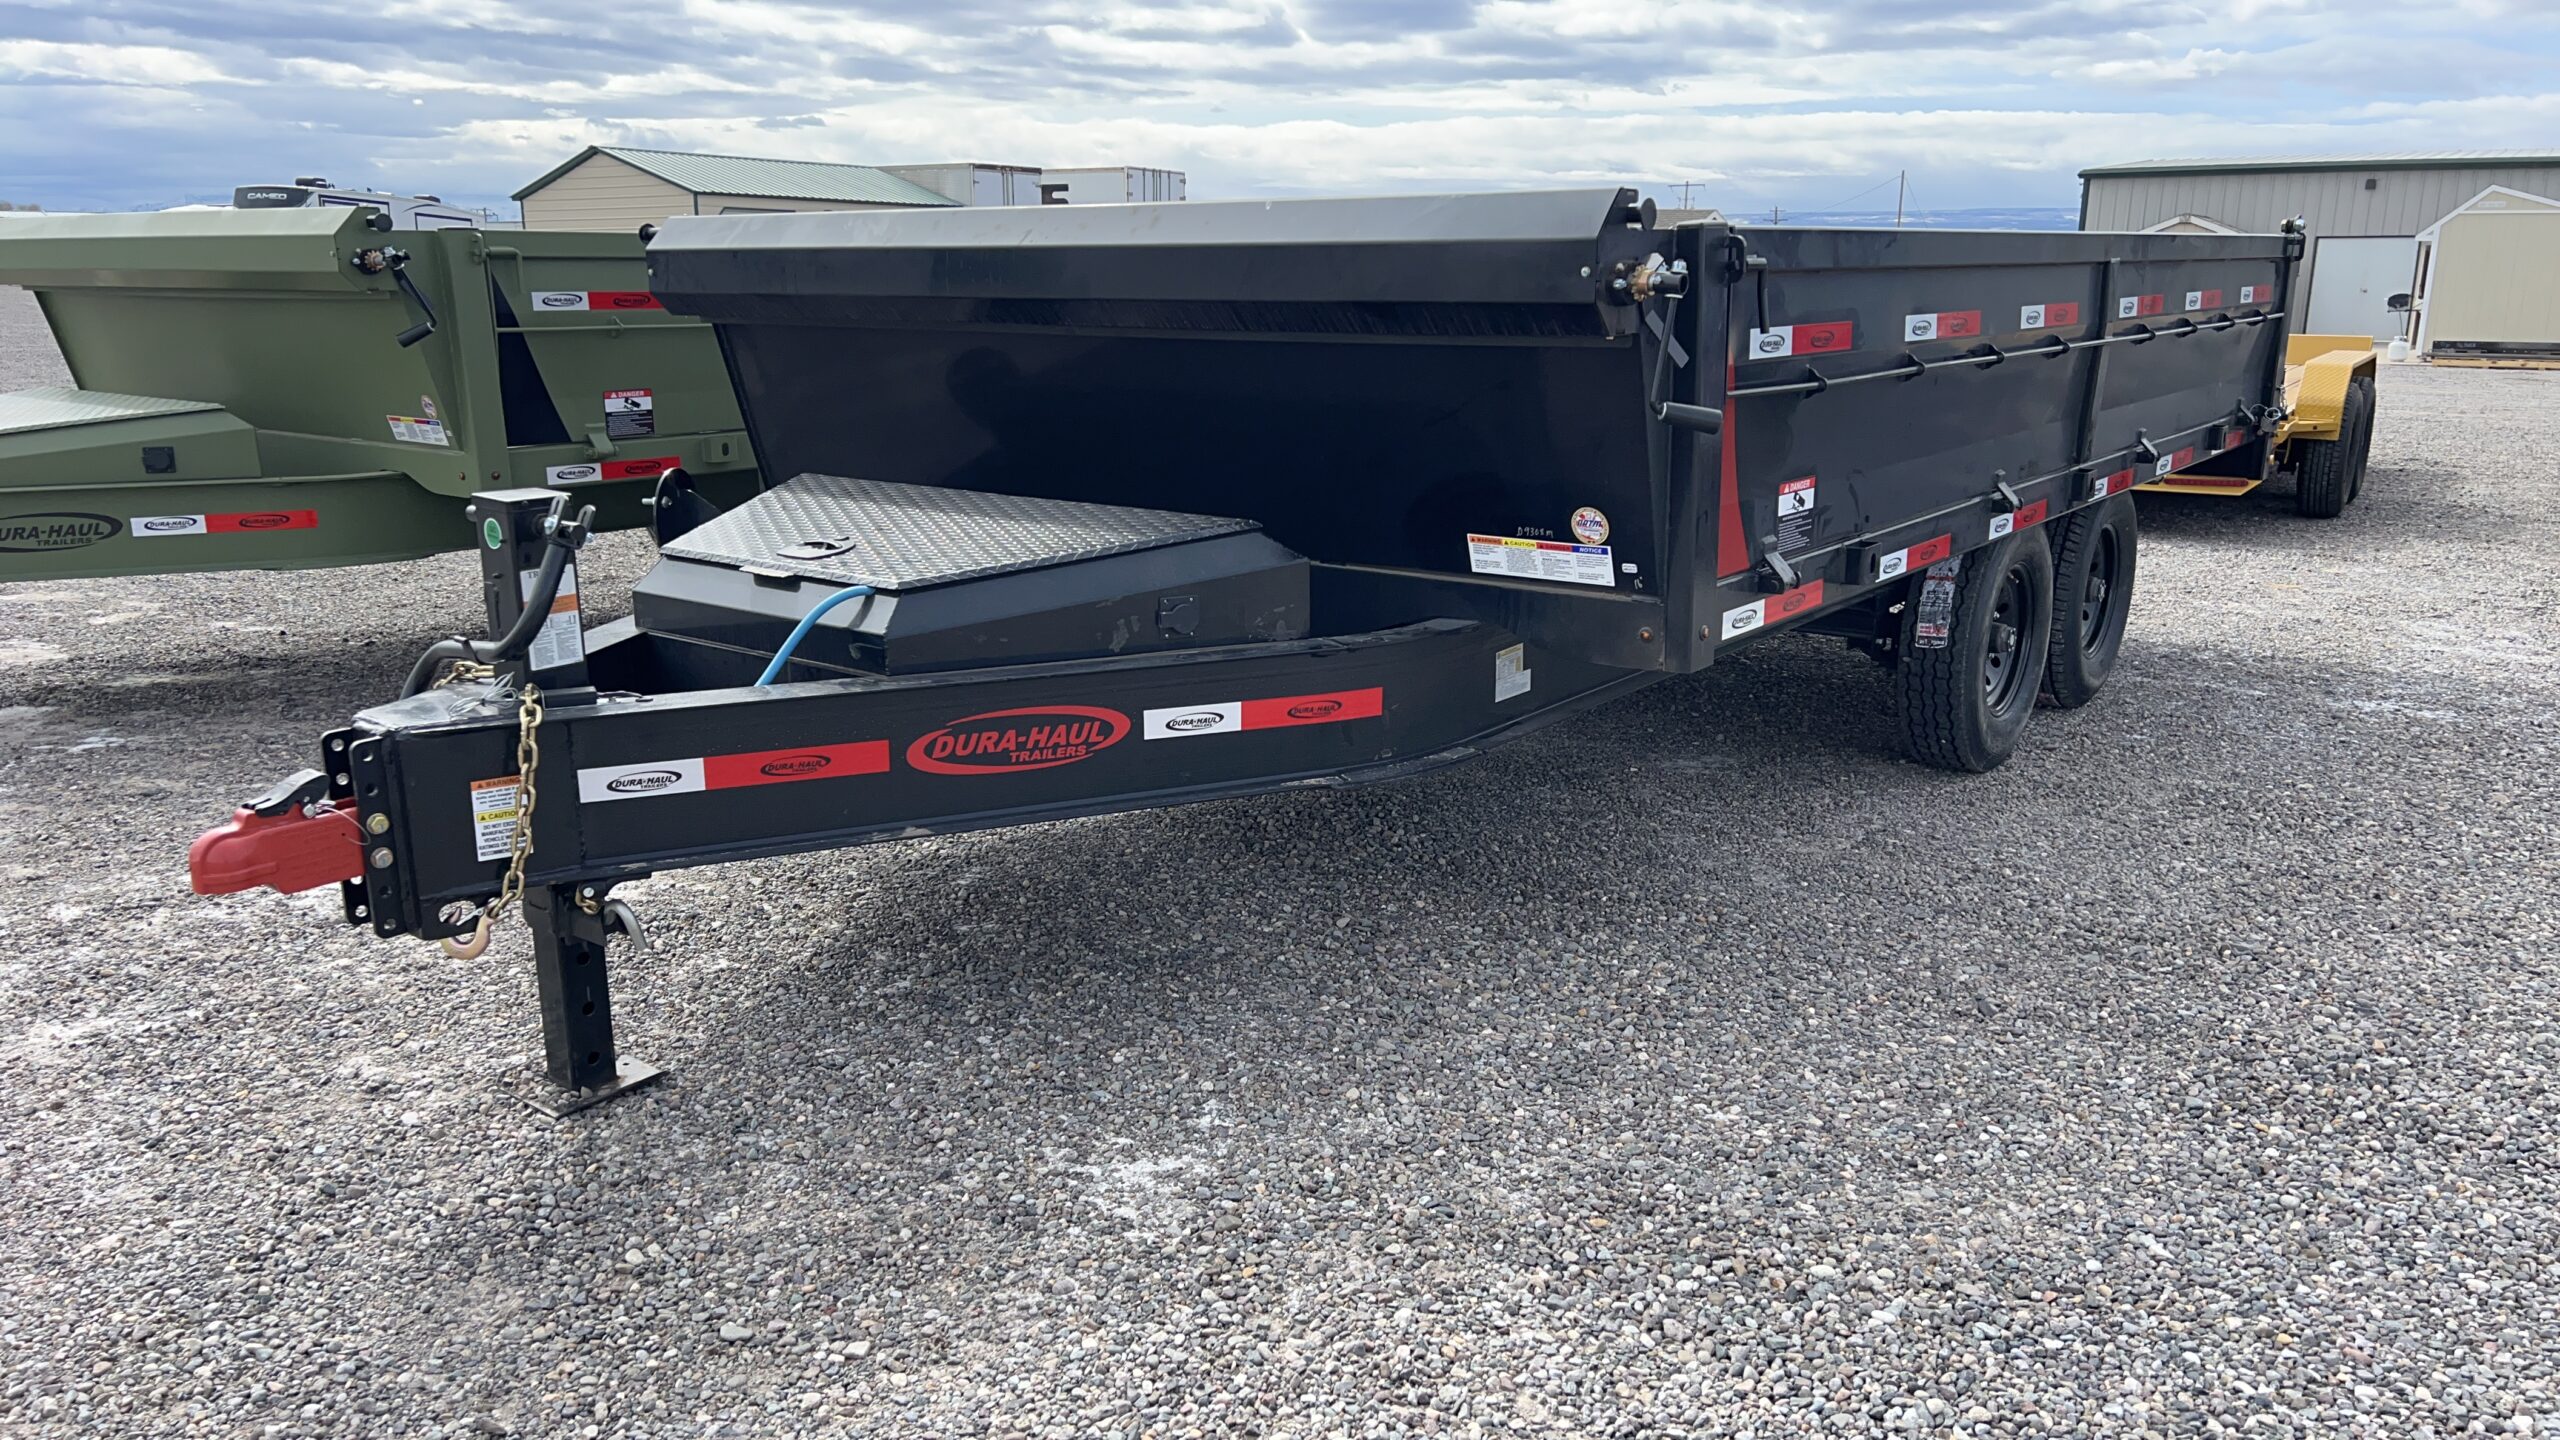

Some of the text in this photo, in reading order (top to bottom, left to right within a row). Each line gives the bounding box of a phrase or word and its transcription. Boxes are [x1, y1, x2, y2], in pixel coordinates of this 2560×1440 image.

[246, 192, 288, 200] CAMEO
[618, 390, 645, 398] DANGER
[1789, 479, 1811, 492] DANGER
[0, 522, 105, 541] URA-HAUL
[36, 538, 93, 547] TRAILERS
[1510, 540, 1536, 548] CAUTION
[1171, 716, 1217, 727] DURA-HAUL
[932, 720, 1105, 759] DURA-HAUL
[1009, 744, 1087, 763] TRAILERS
[767, 759, 822, 772] DURA-HAUL
[486, 777, 520, 787] WARNING
[614, 775, 673, 788] DURA-HAUL
[488, 810, 517, 820] CAUTIO
